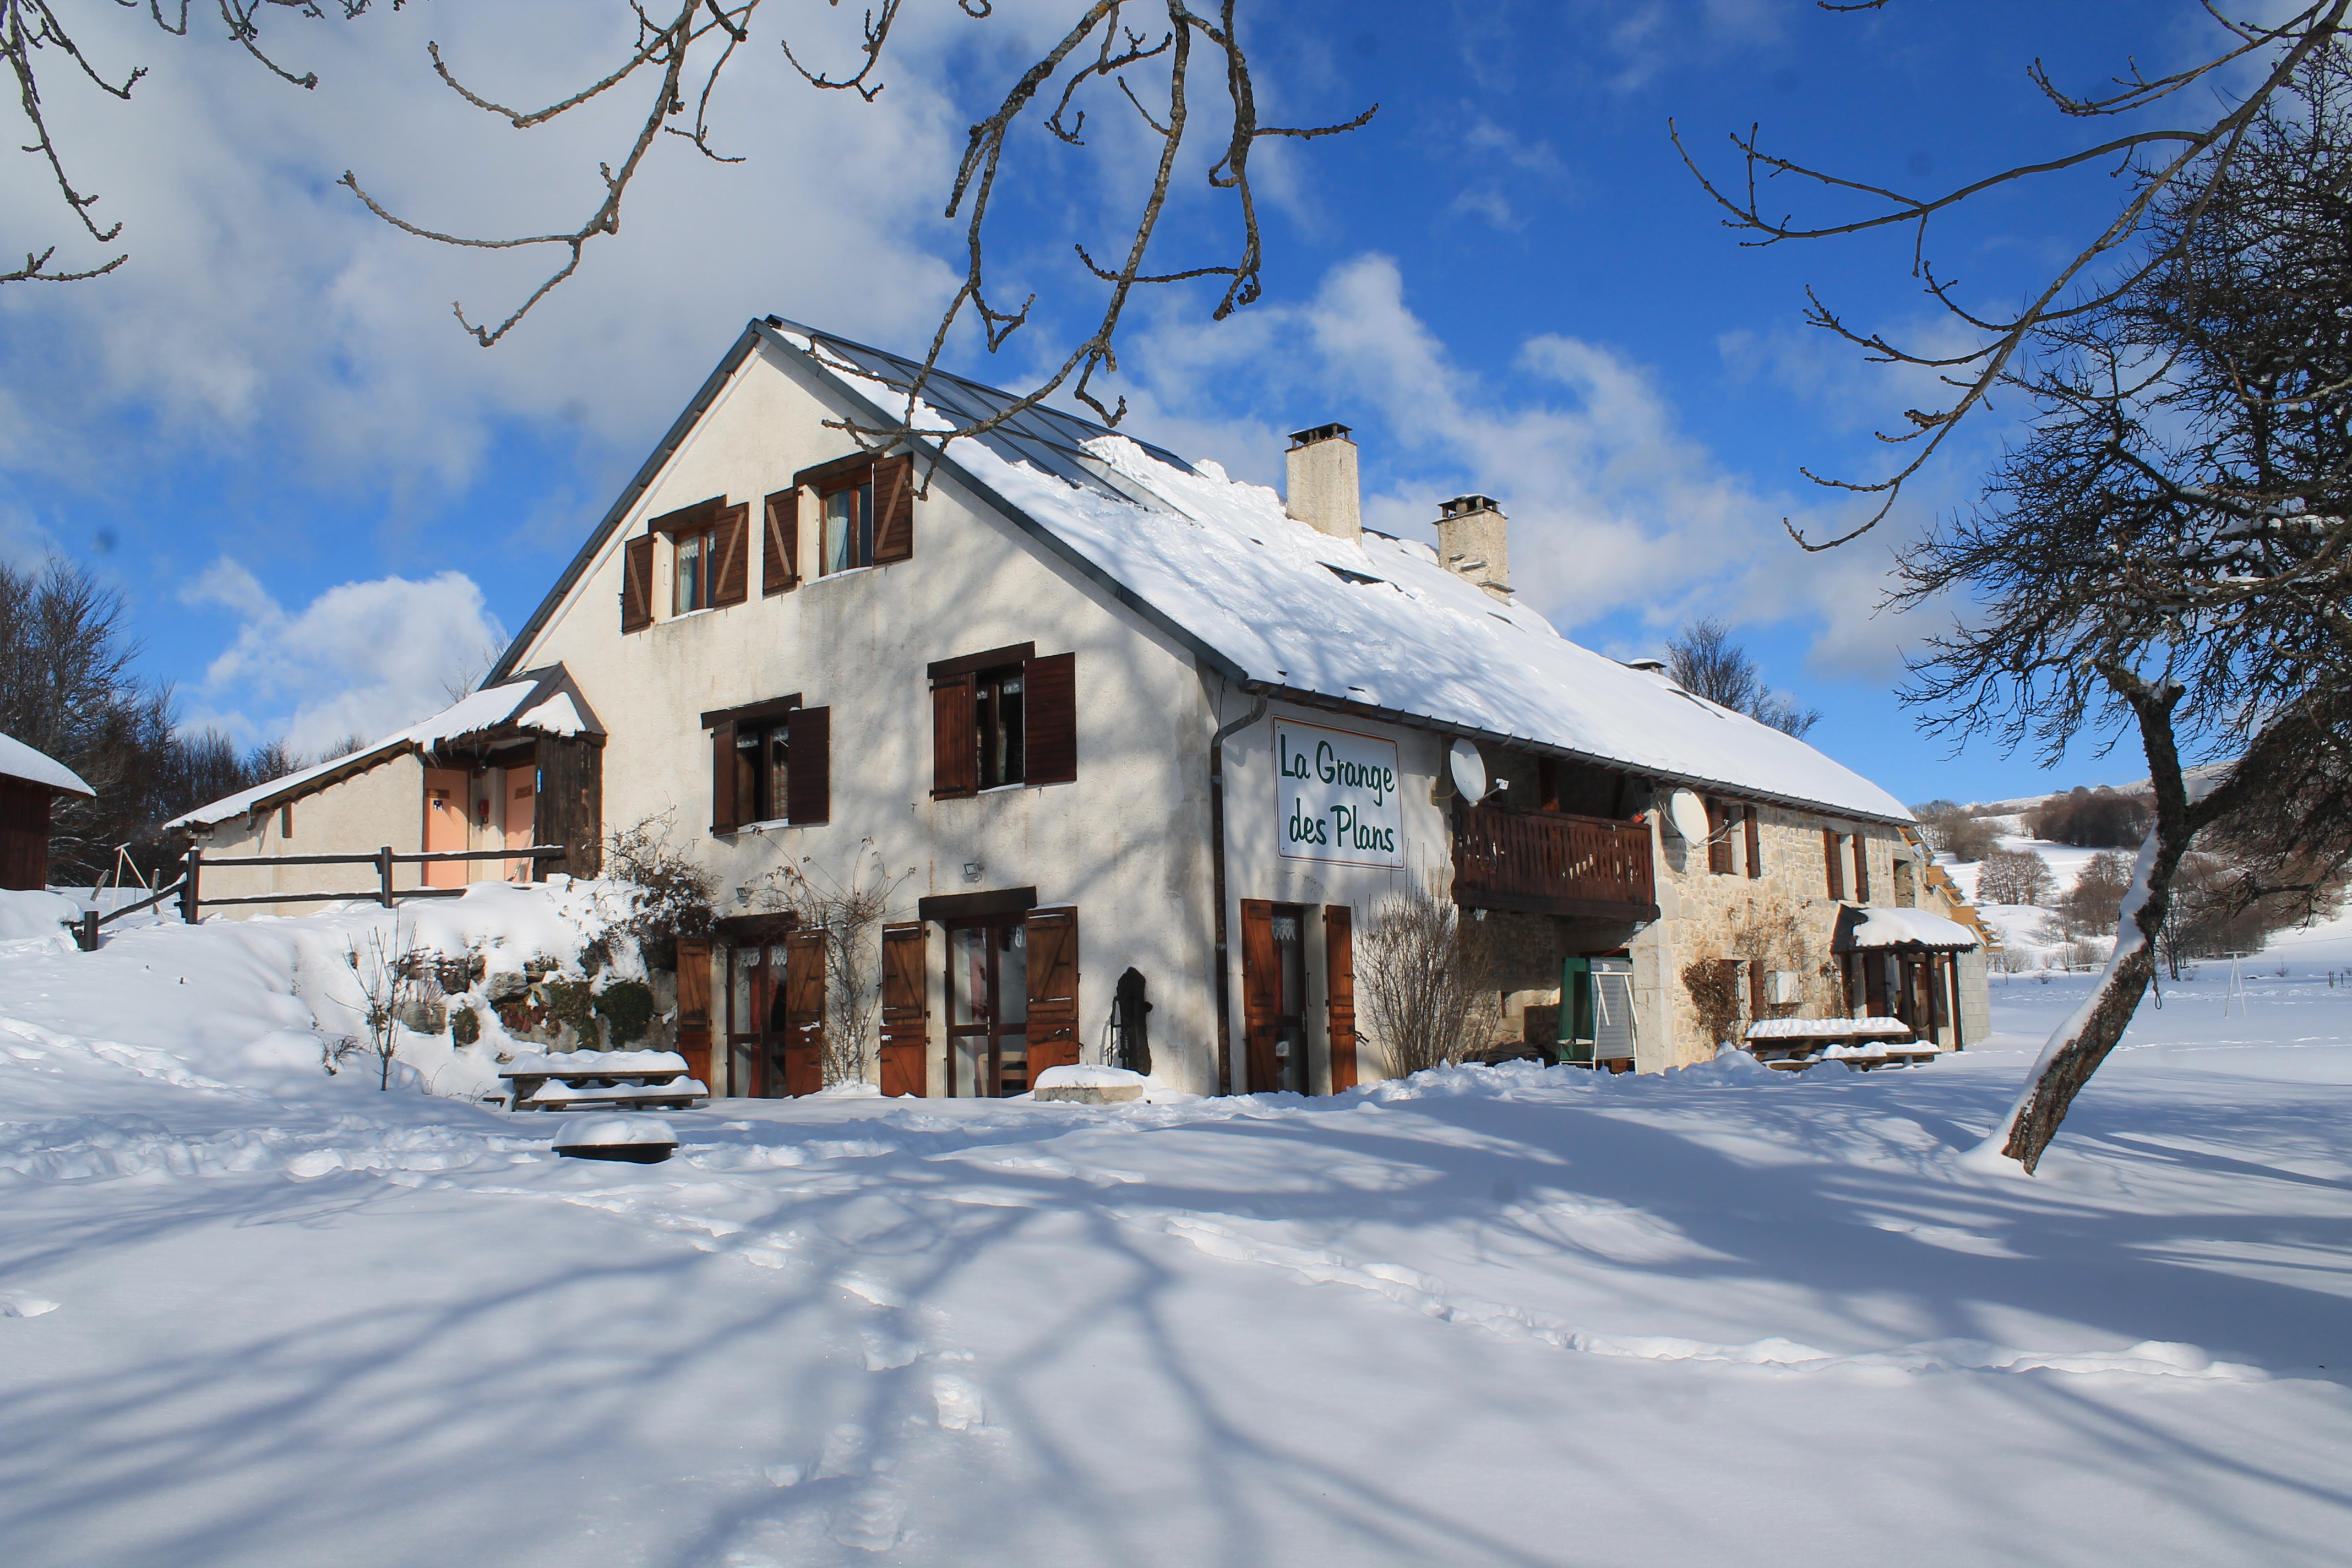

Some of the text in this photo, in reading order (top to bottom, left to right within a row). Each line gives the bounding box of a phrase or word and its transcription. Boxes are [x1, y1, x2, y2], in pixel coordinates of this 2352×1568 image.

[1281, 734, 1395, 807] La Grange
[1289, 797, 1394, 853] des Plans
